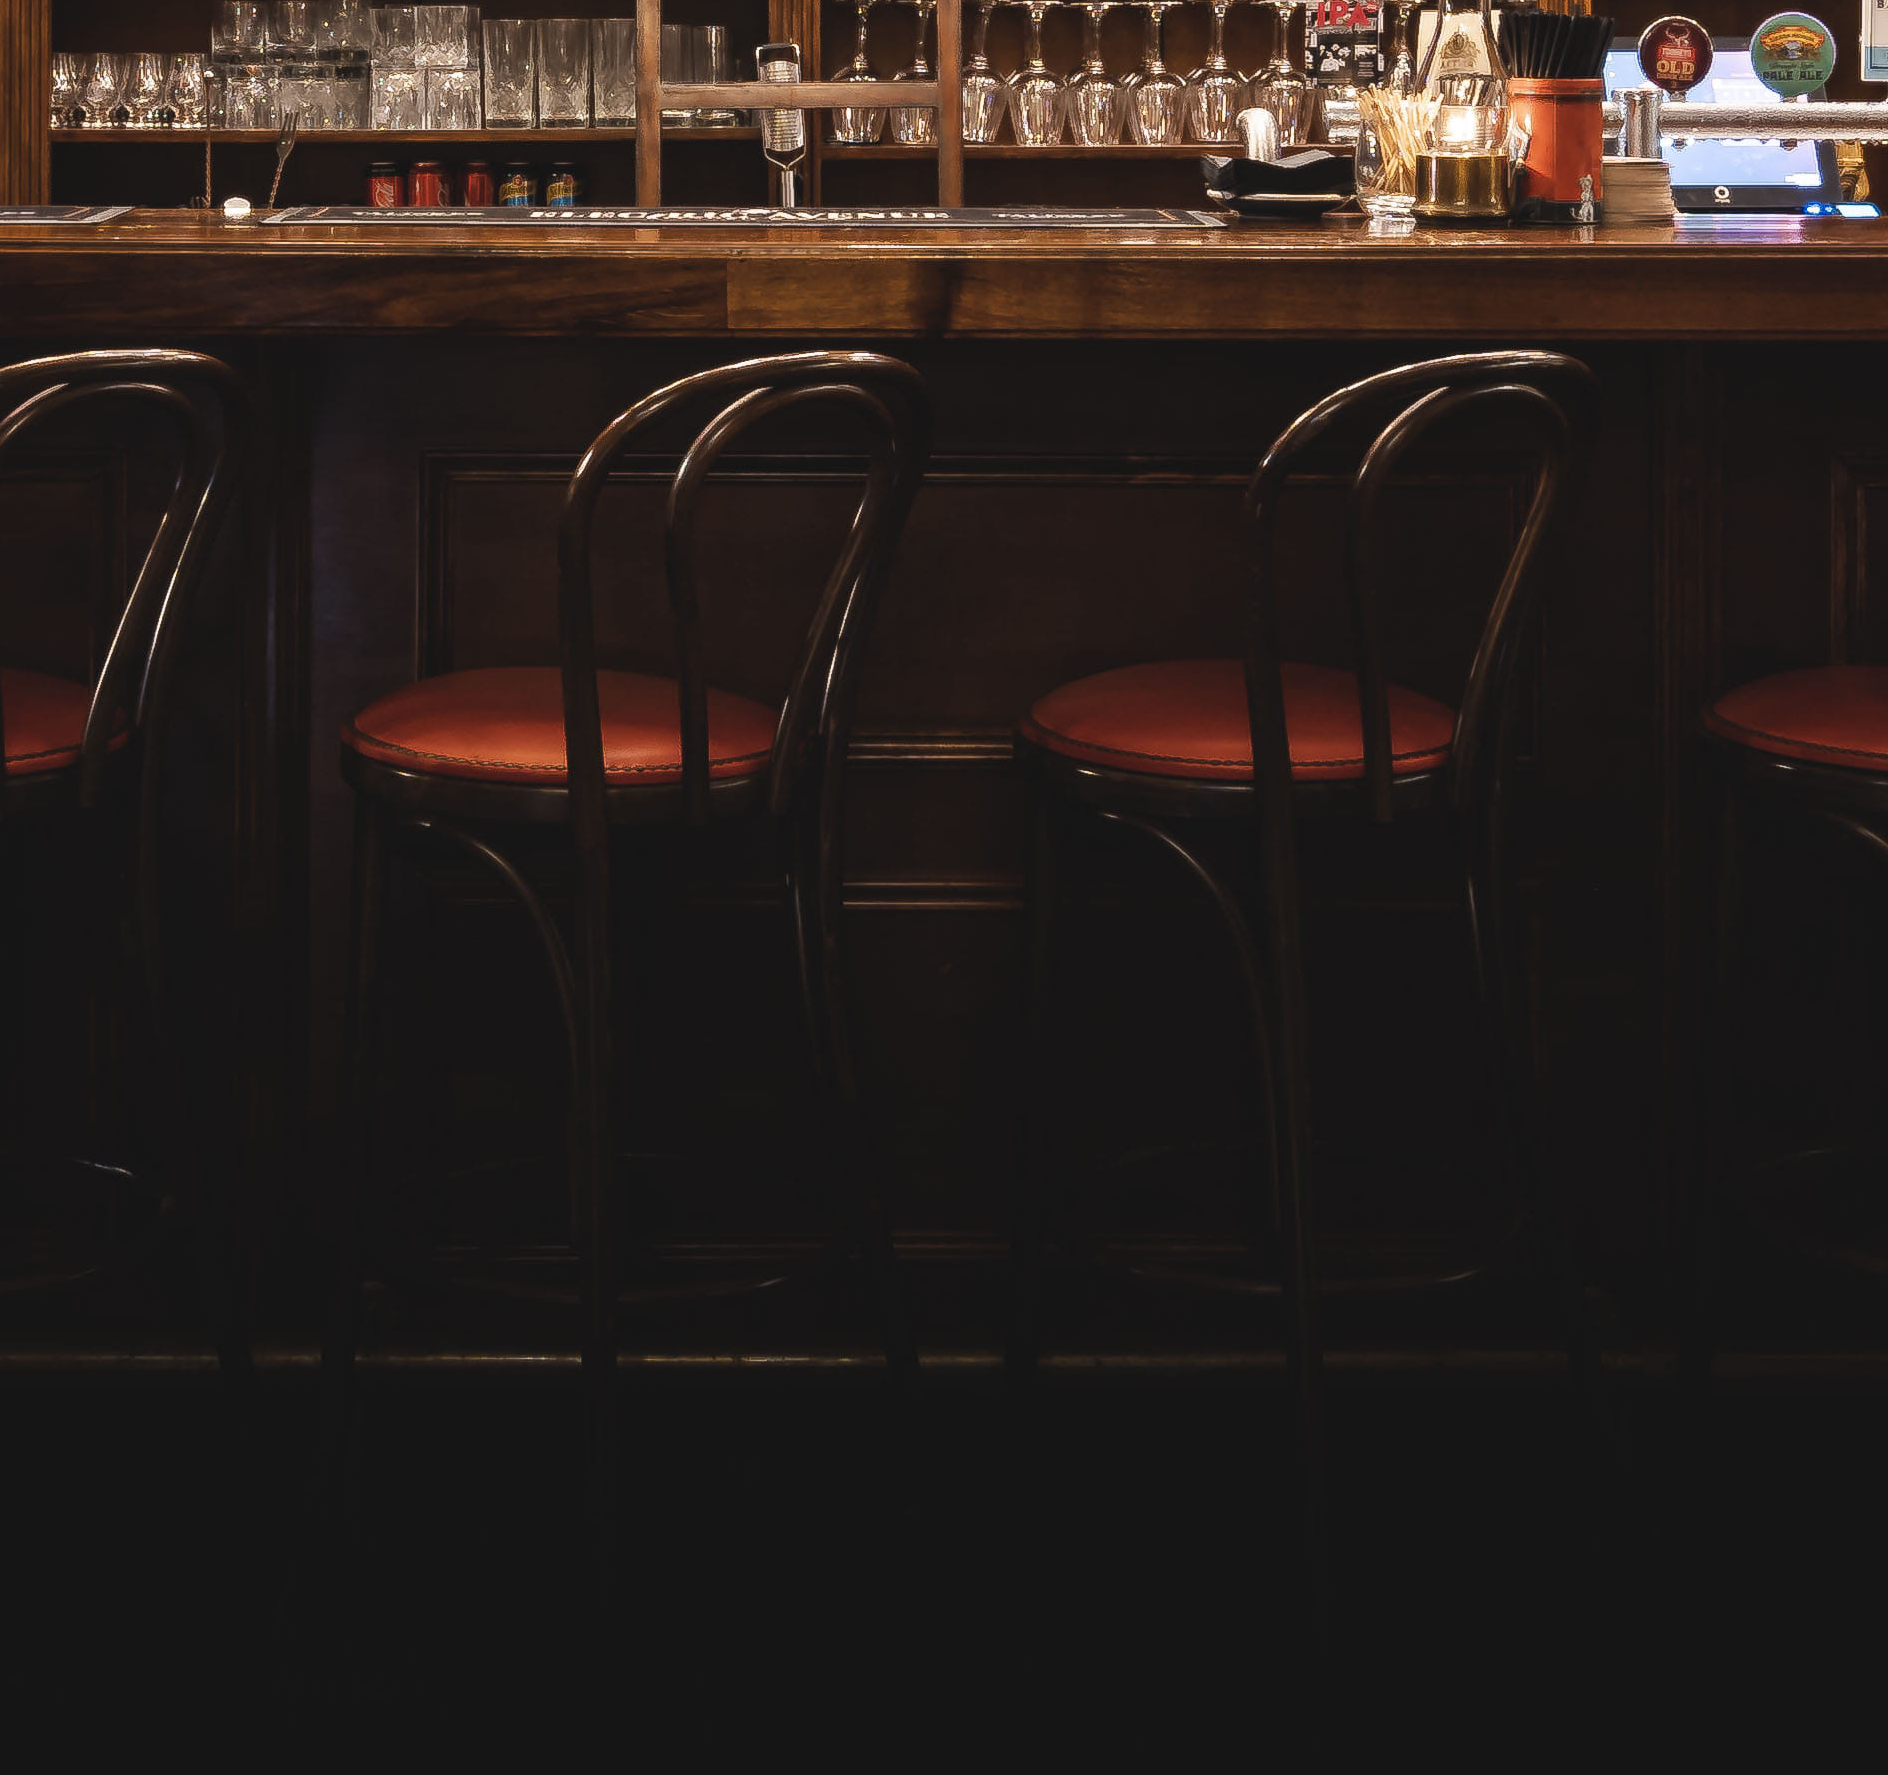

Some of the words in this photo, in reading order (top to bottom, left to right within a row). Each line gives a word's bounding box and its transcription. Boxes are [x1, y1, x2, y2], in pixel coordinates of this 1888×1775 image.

[1317, 0, 1370, 28] IPA
[1656, 61, 1696, 75] OLD
[1763, 71, 1794, 81] PALE
[1798, 71, 1823, 81] ALE
